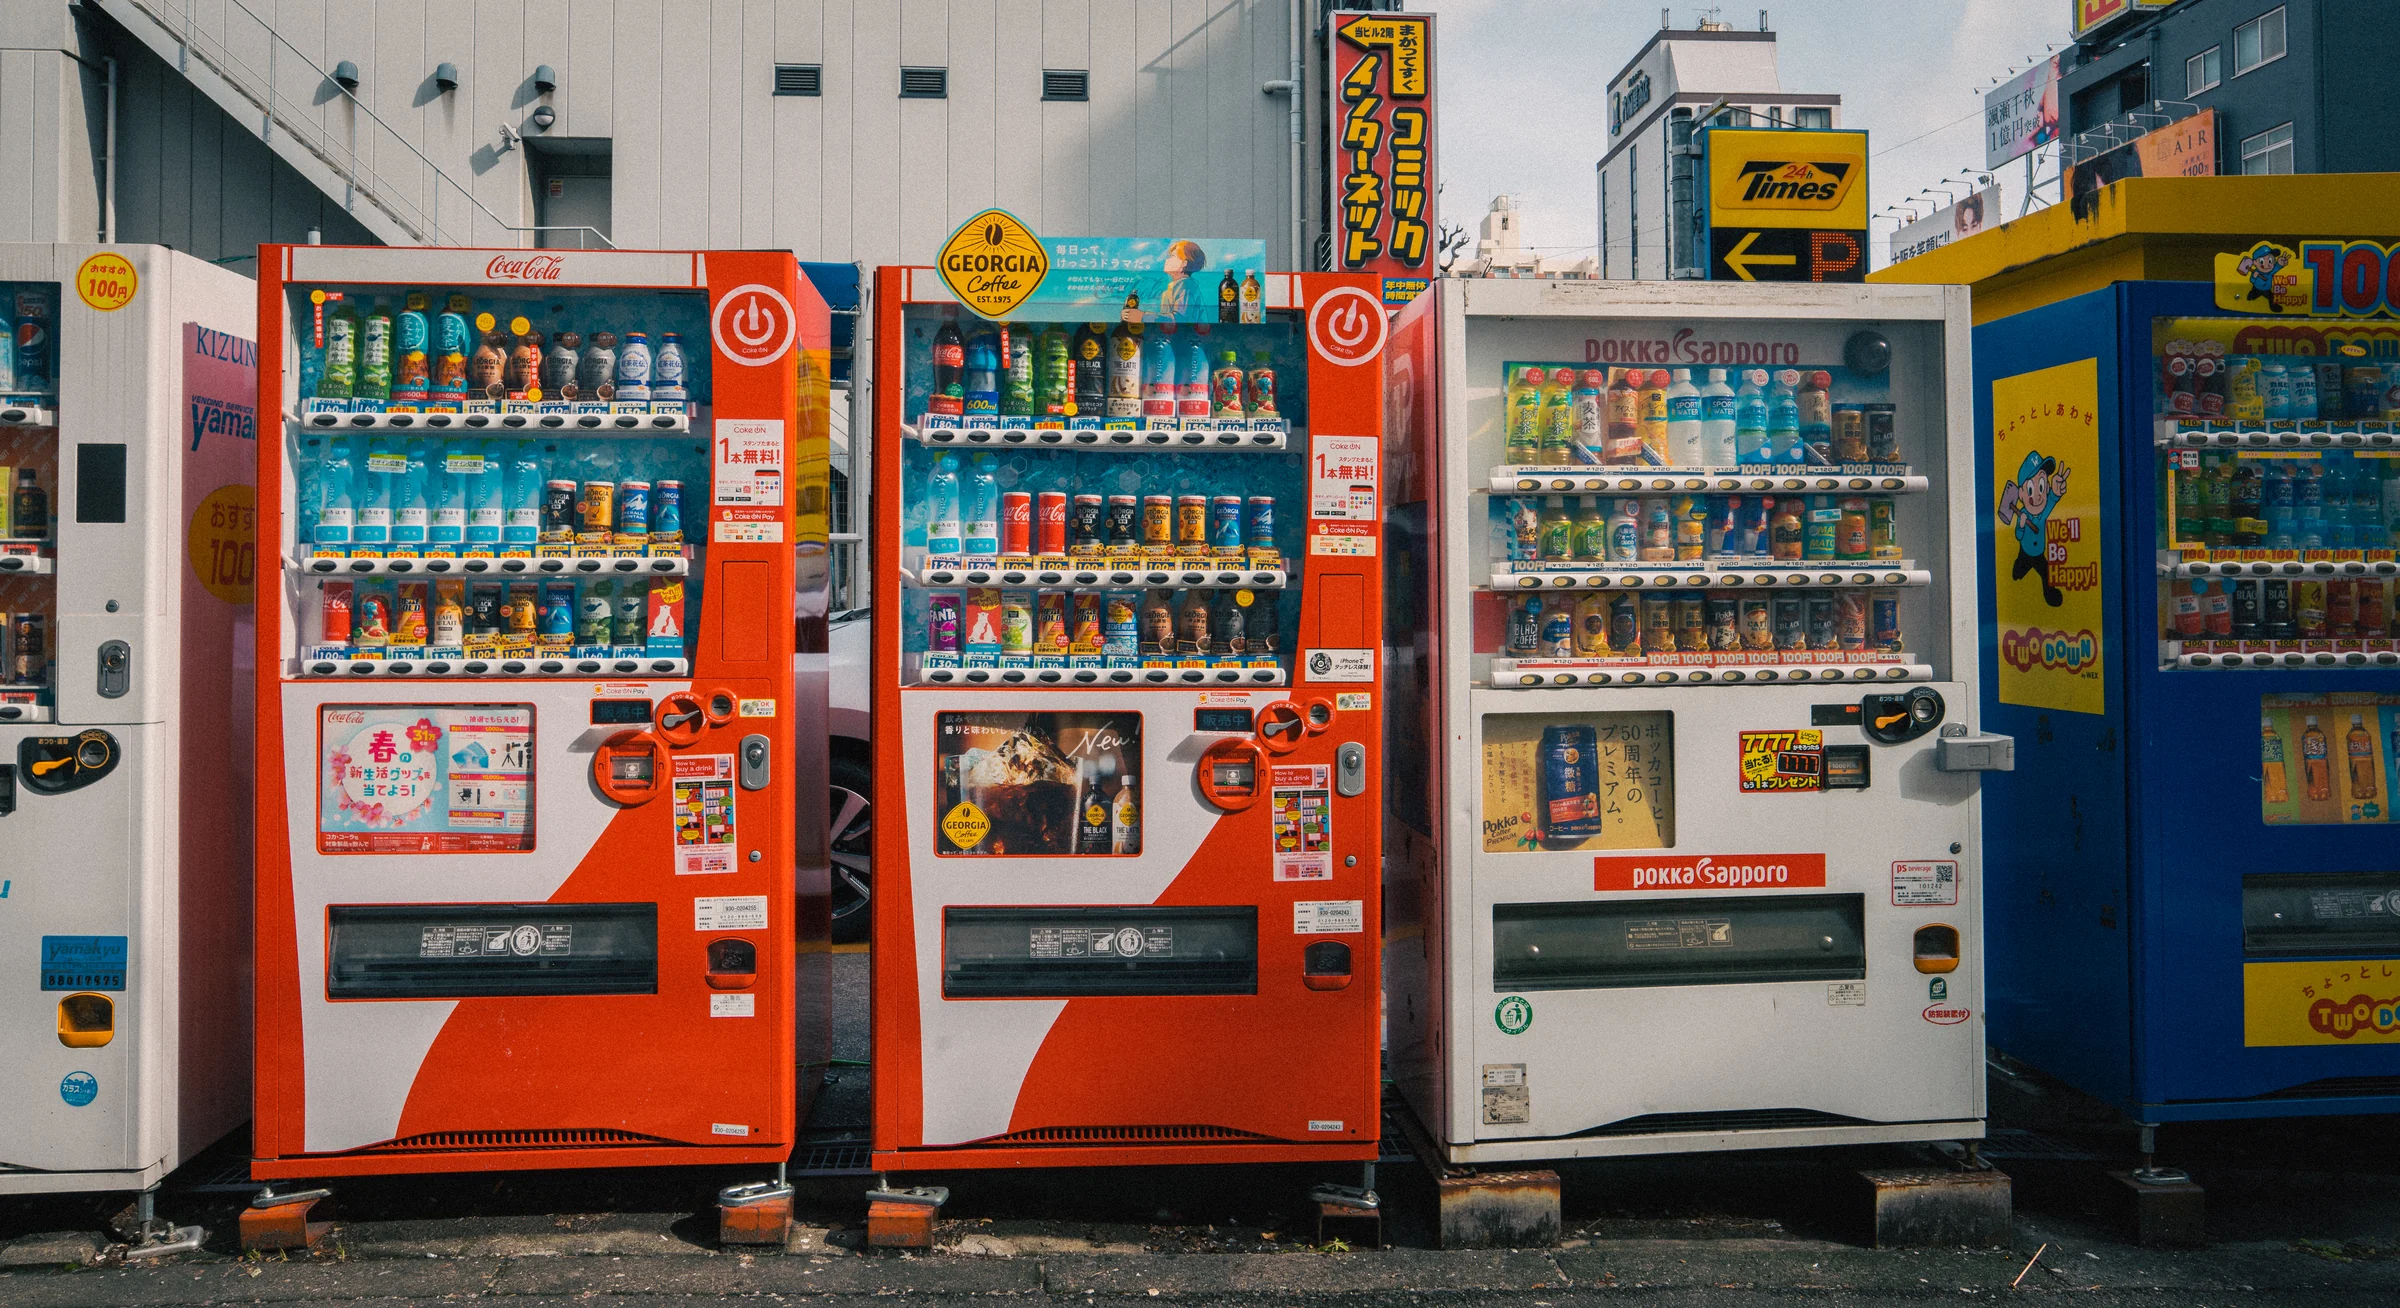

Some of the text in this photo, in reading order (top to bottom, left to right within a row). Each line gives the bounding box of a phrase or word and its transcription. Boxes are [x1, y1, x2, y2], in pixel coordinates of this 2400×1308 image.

[1355, 27, 1394, 39] 当ビル2階
[1398, 25, 1418, 91] まがってすぐ
[1347, 55, 1379, 262] インターネット
[1394, 112, 1422, 258] コミック
[1740, 168, 1841, 201] Times
[1056, 244, 1105, 255] 毎日って、
[1812, 232, 1859, 282] P
[90, 264, 126, 274] おすすめ
[486, 254, 566, 280] Coca-Cola
[949, 254, 1040, 273] GEORGIA
[1057, 258, 1150, 269] けっこうドラマだ。
[967, 274, 1022, 294] Coffee
[1385, 281, 1426, 290] 年中無休
[2273, 276, 2296, 286] We'll
[1386, 291, 1422, 300] 時間営
[2273, 286, 2286, 294] Be
[2273, 294, 2307, 306] Happy!
[192, 396, 253, 414] VENDING SERVICE
[1582, 402, 1597, 431] 麦茶
[1998, 403, 2093, 441] ちょっとしあわせ
[191, 403, 256, 451] yama
[719, 438, 780, 464] 1本無料!
[1316, 453, 1374, 480] 1本無料!
[1740, 464, 1772, 475] 100円
[1776, 464, 1807, 475] 100円
[1842, 464, 1872, 475] 100円
[1875, 464, 1905, 475] 100円
[2048, 520, 2079, 539] We'll
[2049, 544, 2066, 561] Be
[1514, 560, 1546, 571] 100円
[2049, 564, 2096, 589] Happy!
[930, 609, 956, 622] FANTA
[1649, 654, 1679, 665] 100円
[1683, 654, 1712, 665] 100円
[1715, 653, 1745, 664] 100円
[1748, 653, 1779, 664] 100円
[2008, 639, 2091, 665] TWO DOWN
[328, 711, 365, 724] Coca-Cola
[1203, 715, 1245, 726] 販売中
[413, 730, 436, 741] 31万
[1742, 734, 1795, 751] 7777
[368, 730, 412, 763] 春の
[1621, 725, 1642, 803] 50周年の
[1744, 754, 1773, 770] 当たる!
[1781, 754, 1818, 771] 7777
[350, 765, 431, 781] 新生活グッズを
[1602, 725, 1623, 824] プレミアム。
[1645, 724, 1664, 838] ポッカコーヒー
[1743, 774, 1820, 788] もう1本プレゼント!
[363, 784, 416, 797] 当てよう!
[946, 821, 986, 830] GEORGIA
[1083, 826, 1107, 834] THE BLACK
[1483, 816, 1518, 834] Pokka
[954, 830, 978, 838] Coffee
[50, 938, 121, 961] yamakyu
[2302, 964, 2392, 999] ちょっとし
[1928, 1010, 1967, 1018] 防犯装置付
[2318, 1003, 2370, 1031] TWO
[1500, 1023, 1529, 1034] リサイクル
